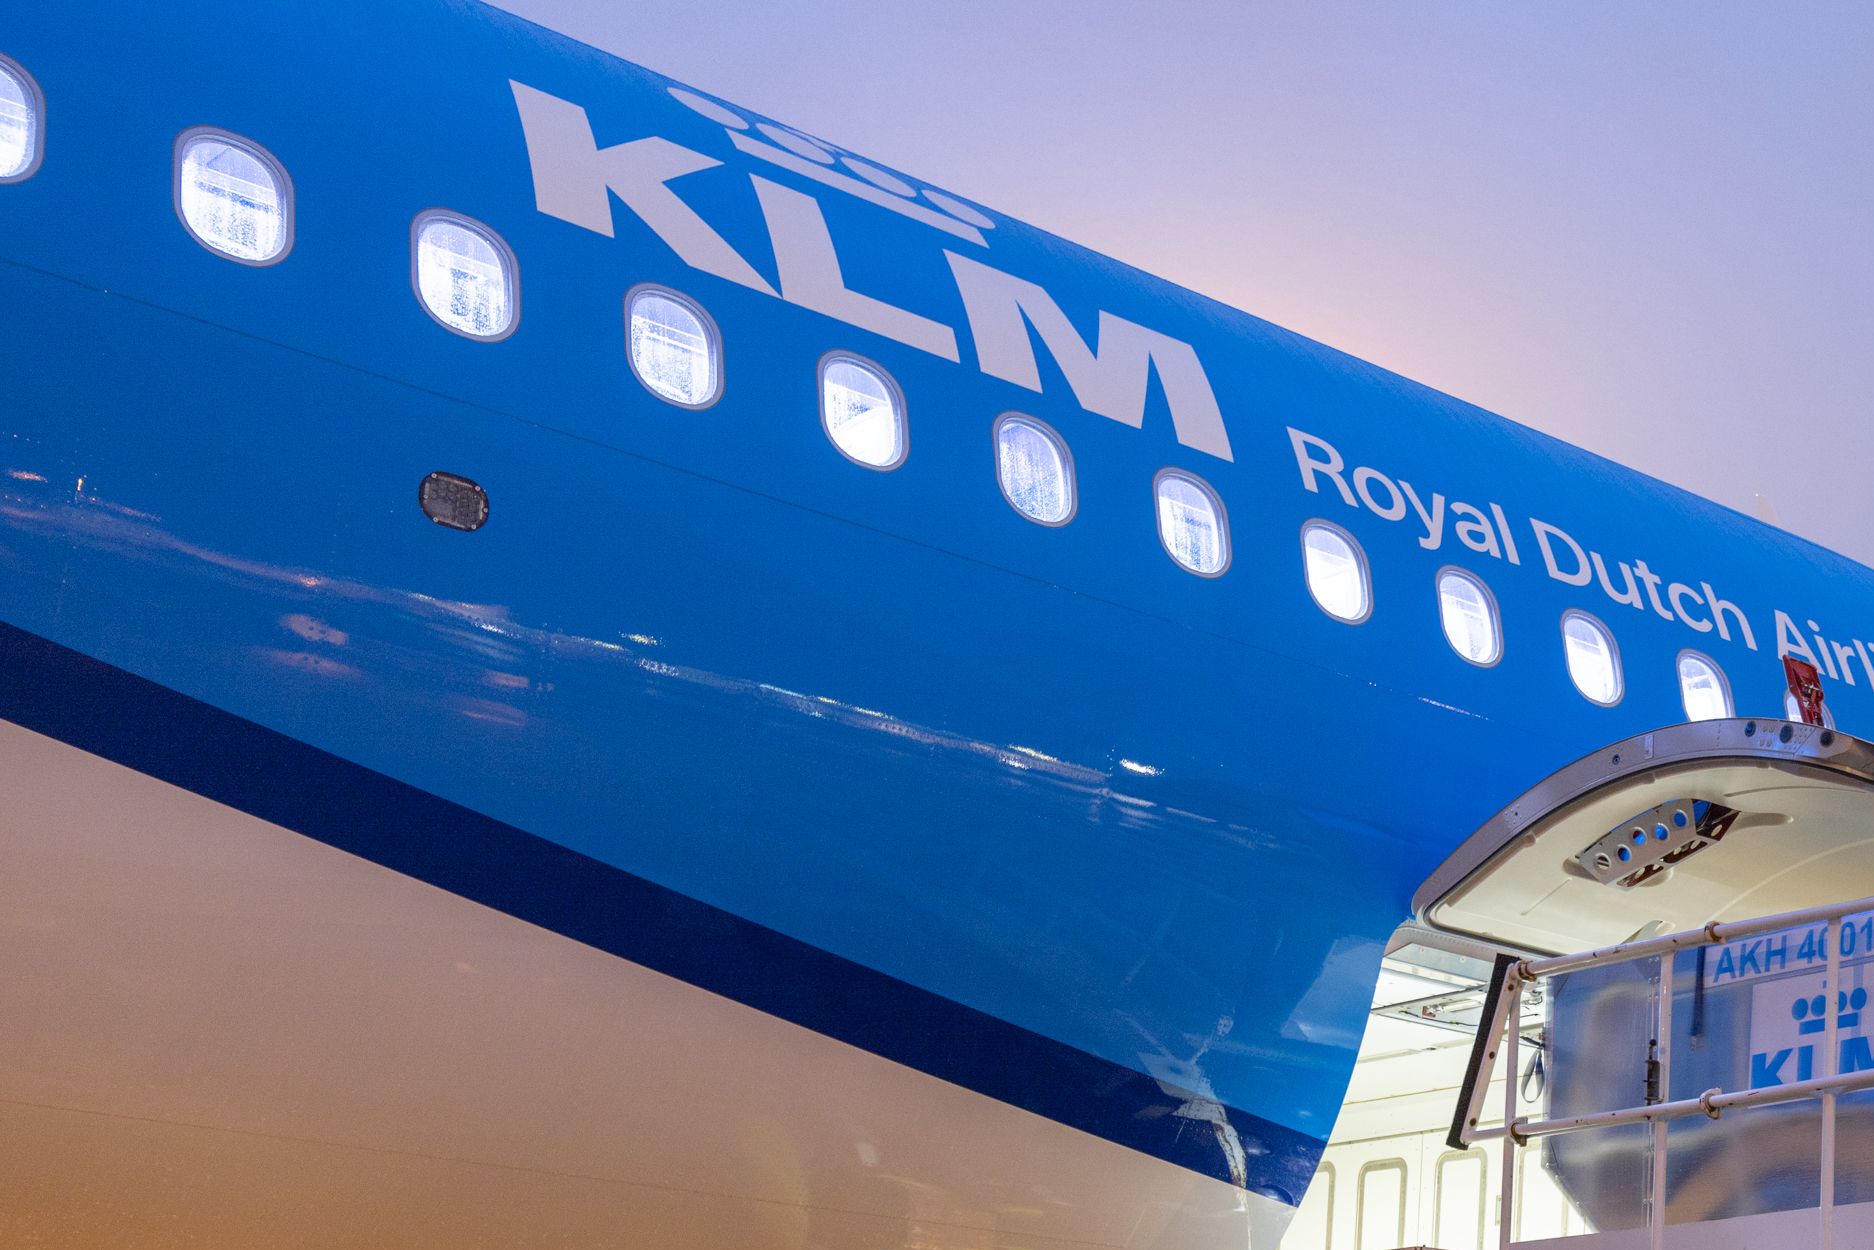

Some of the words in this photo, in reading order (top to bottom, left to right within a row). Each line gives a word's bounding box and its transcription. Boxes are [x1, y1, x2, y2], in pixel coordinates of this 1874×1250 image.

[508, 78, 1234, 463] KLM
[1286, 426, 1521, 566] Royal
[1529, 517, 1758, 651] Dutch
[1713, 934, 1788, 983] AKH
